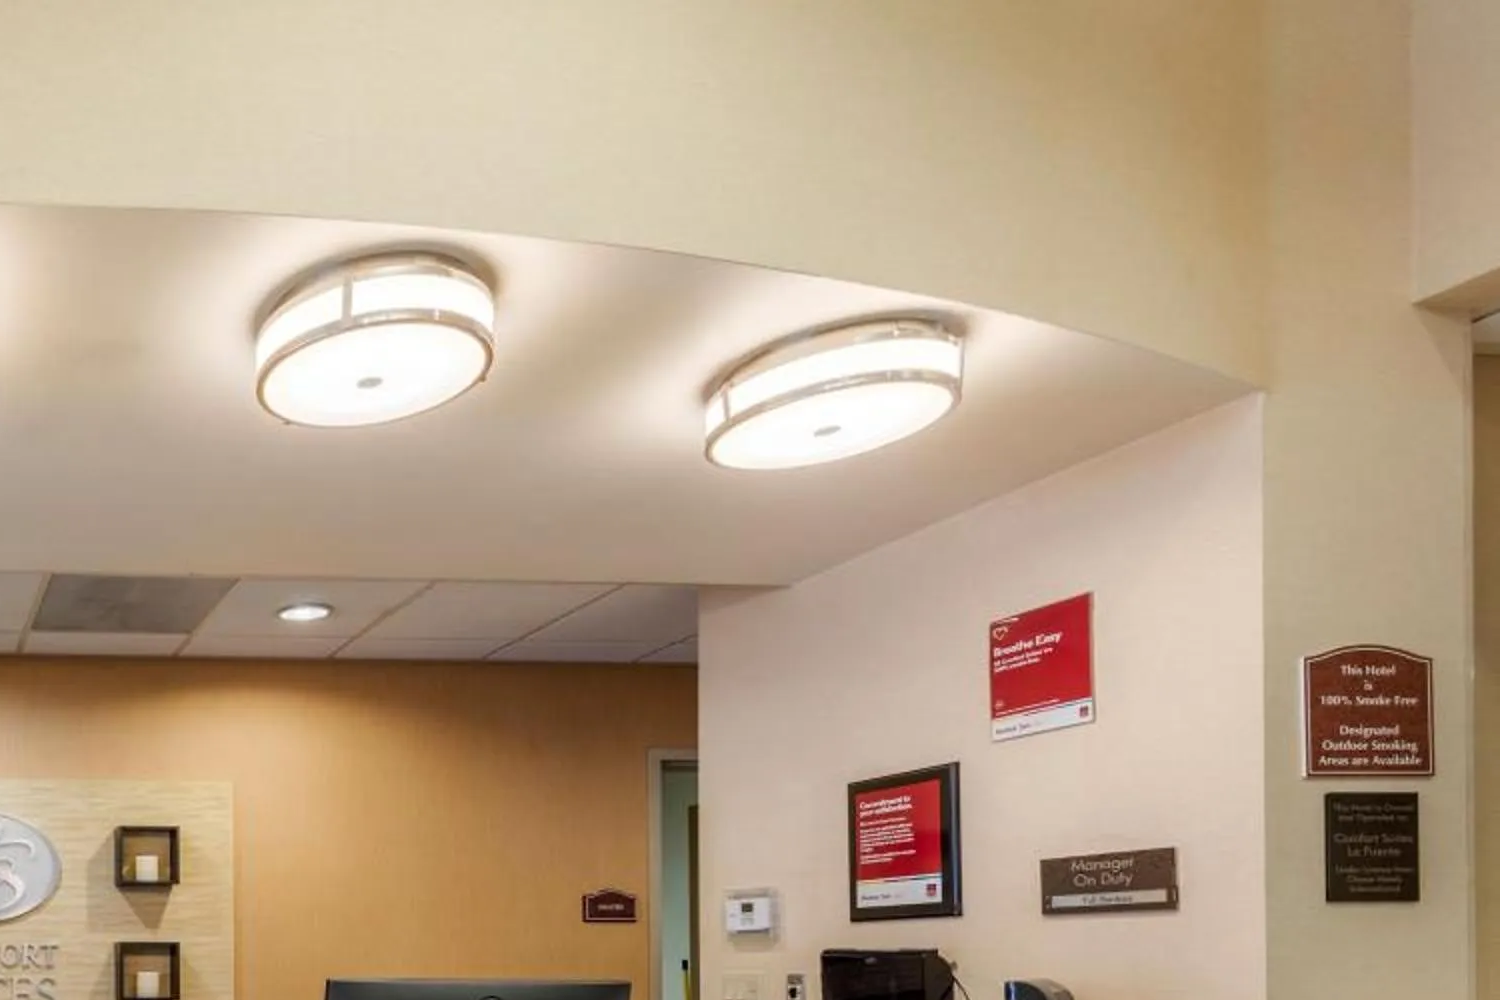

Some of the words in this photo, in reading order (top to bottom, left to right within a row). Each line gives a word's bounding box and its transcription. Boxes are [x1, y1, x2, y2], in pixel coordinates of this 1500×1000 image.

[1035, 632, 1062, 646] Easy
[1340, 665, 1362, 676] This
[1365, 665, 1396, 676] Hotel
[1363, 680, 1373, 691] is
[1320, 695, 1352, 706] 100%
[1355, 695, 1391, 706] Smoke
[1393, 695, 1418, 706] Free
[1339, 725, 1399, 738] Designated
[1322, 740, 1368, 751] Outdoor
[1371, 739, 1418, 753] Smoking
[1319, 755, 1349, 766] Areas
[1351, 757, 1369, 766] are
[1372, 755, 1422, 766] Available
[1073, 873, 1097, 887] On
[1101, 872, 1133, 886] Duty
